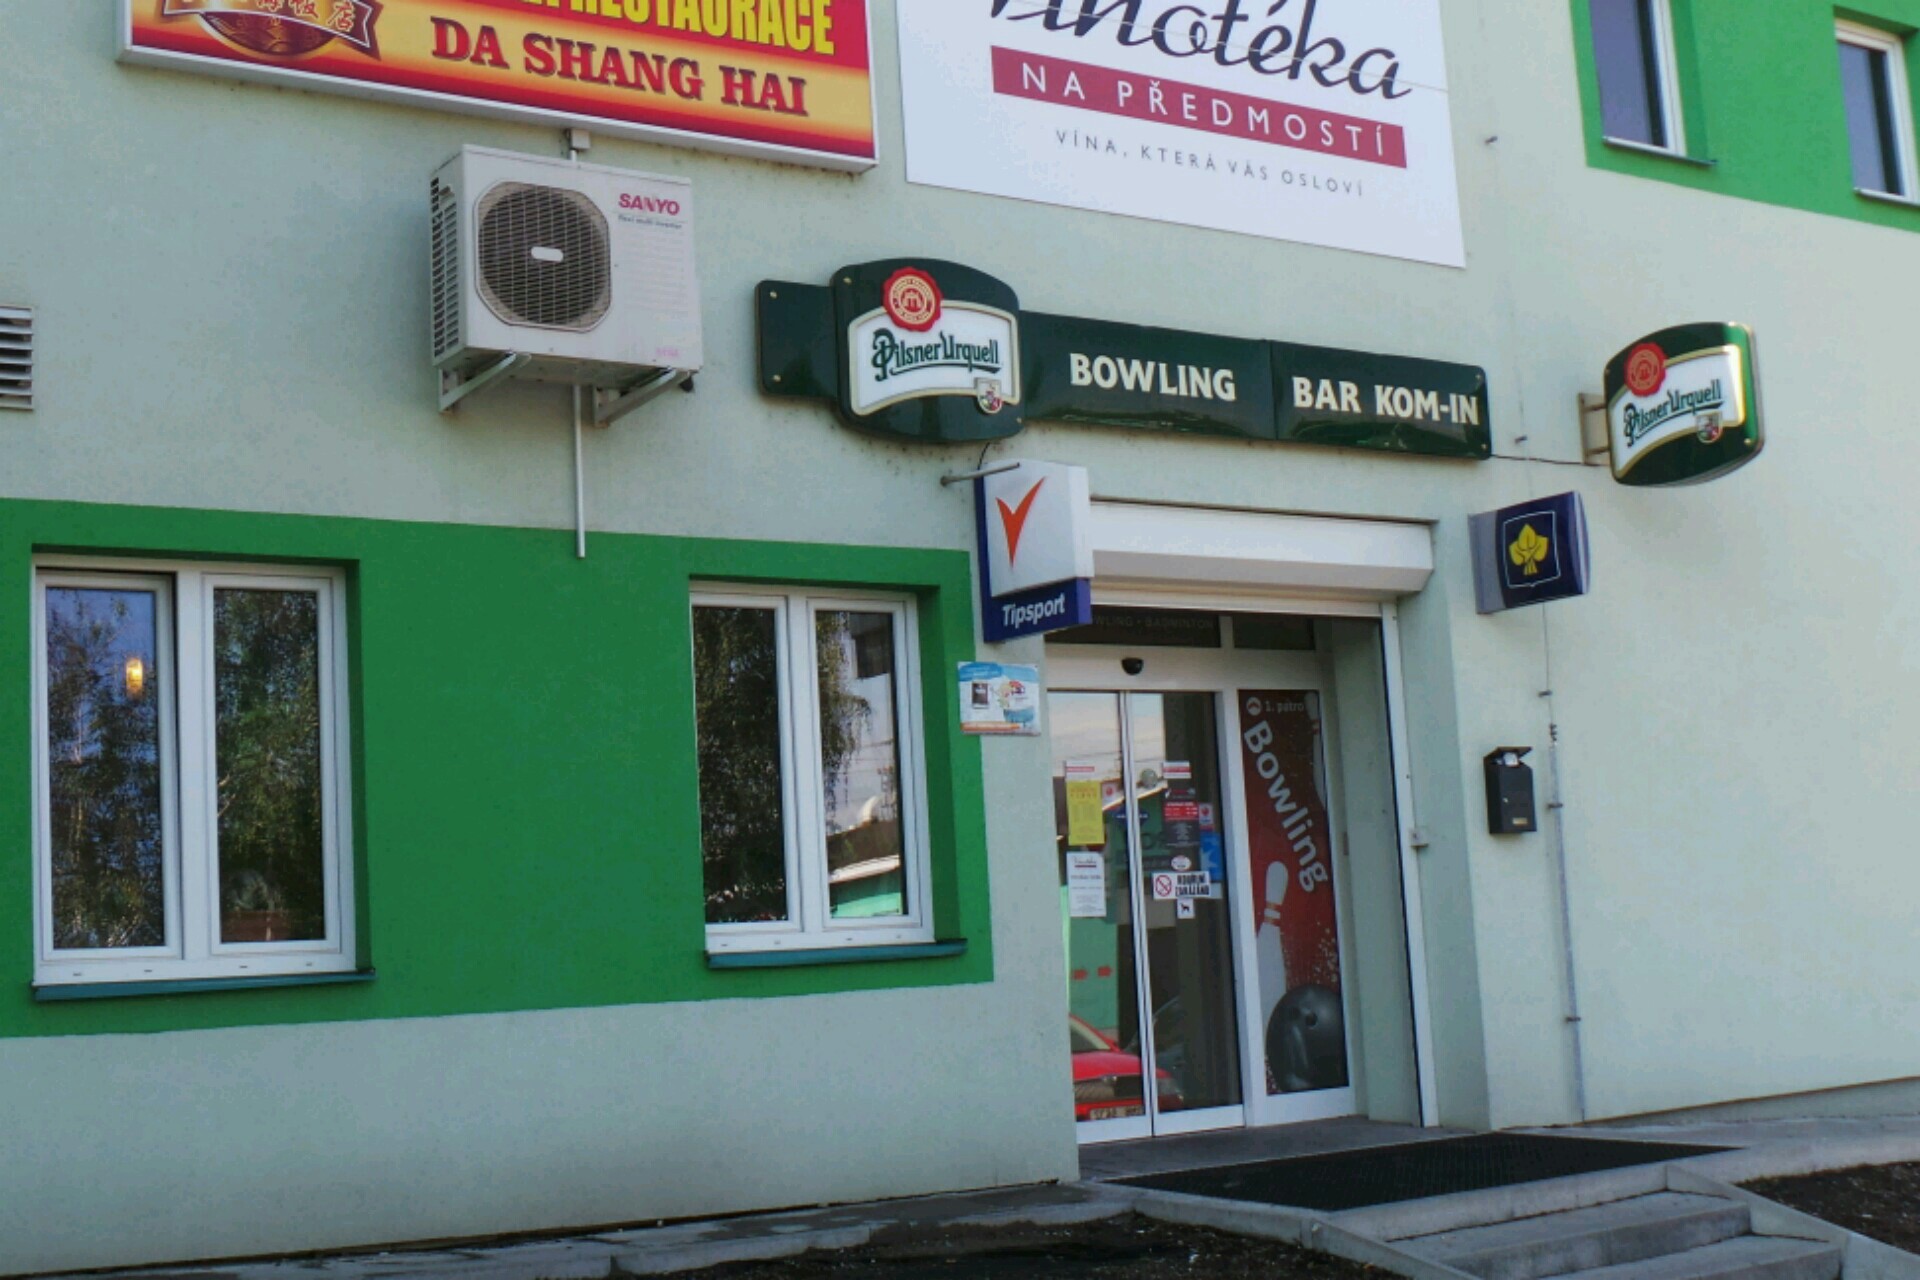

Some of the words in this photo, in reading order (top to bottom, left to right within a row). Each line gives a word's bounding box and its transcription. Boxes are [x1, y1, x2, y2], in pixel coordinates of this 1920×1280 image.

[569, 0, 834, 55] AURACE
[430, 16, 510, 69] DA
[523, 33, 704, 101] SHANG
[719, 65, 810, 117] HAI
[1022, 62, 1085, 100] NA
[1117, 79, 1384, 157] PŘEDMOSTÍ
[1056, 129, 1129, 158] VÍNA,
[1141, 145, 1216, 172] KTERÁ
[1228, 160, 1268, 181] VÁS
[1281, 170, 1364, 197] OSLOVÍ
[618, 193, 680, 216] SANYO
[871, 327, 943, 382] Pilsner
[939, 330, 1000, 373] Urquell
[1070, 353, 1236, 401] BOWLING
[1292, 376, 1362, 414] BAR
[1374, 384, 1480, 425] KOM-IN
[1623, 402, 1671, 448] Pilsner
[1667, 378, 1722, 416] Urquell
[1002, 592, 1066, 629] Tipsport
[1244, 719, 1329, 893] Bowling
